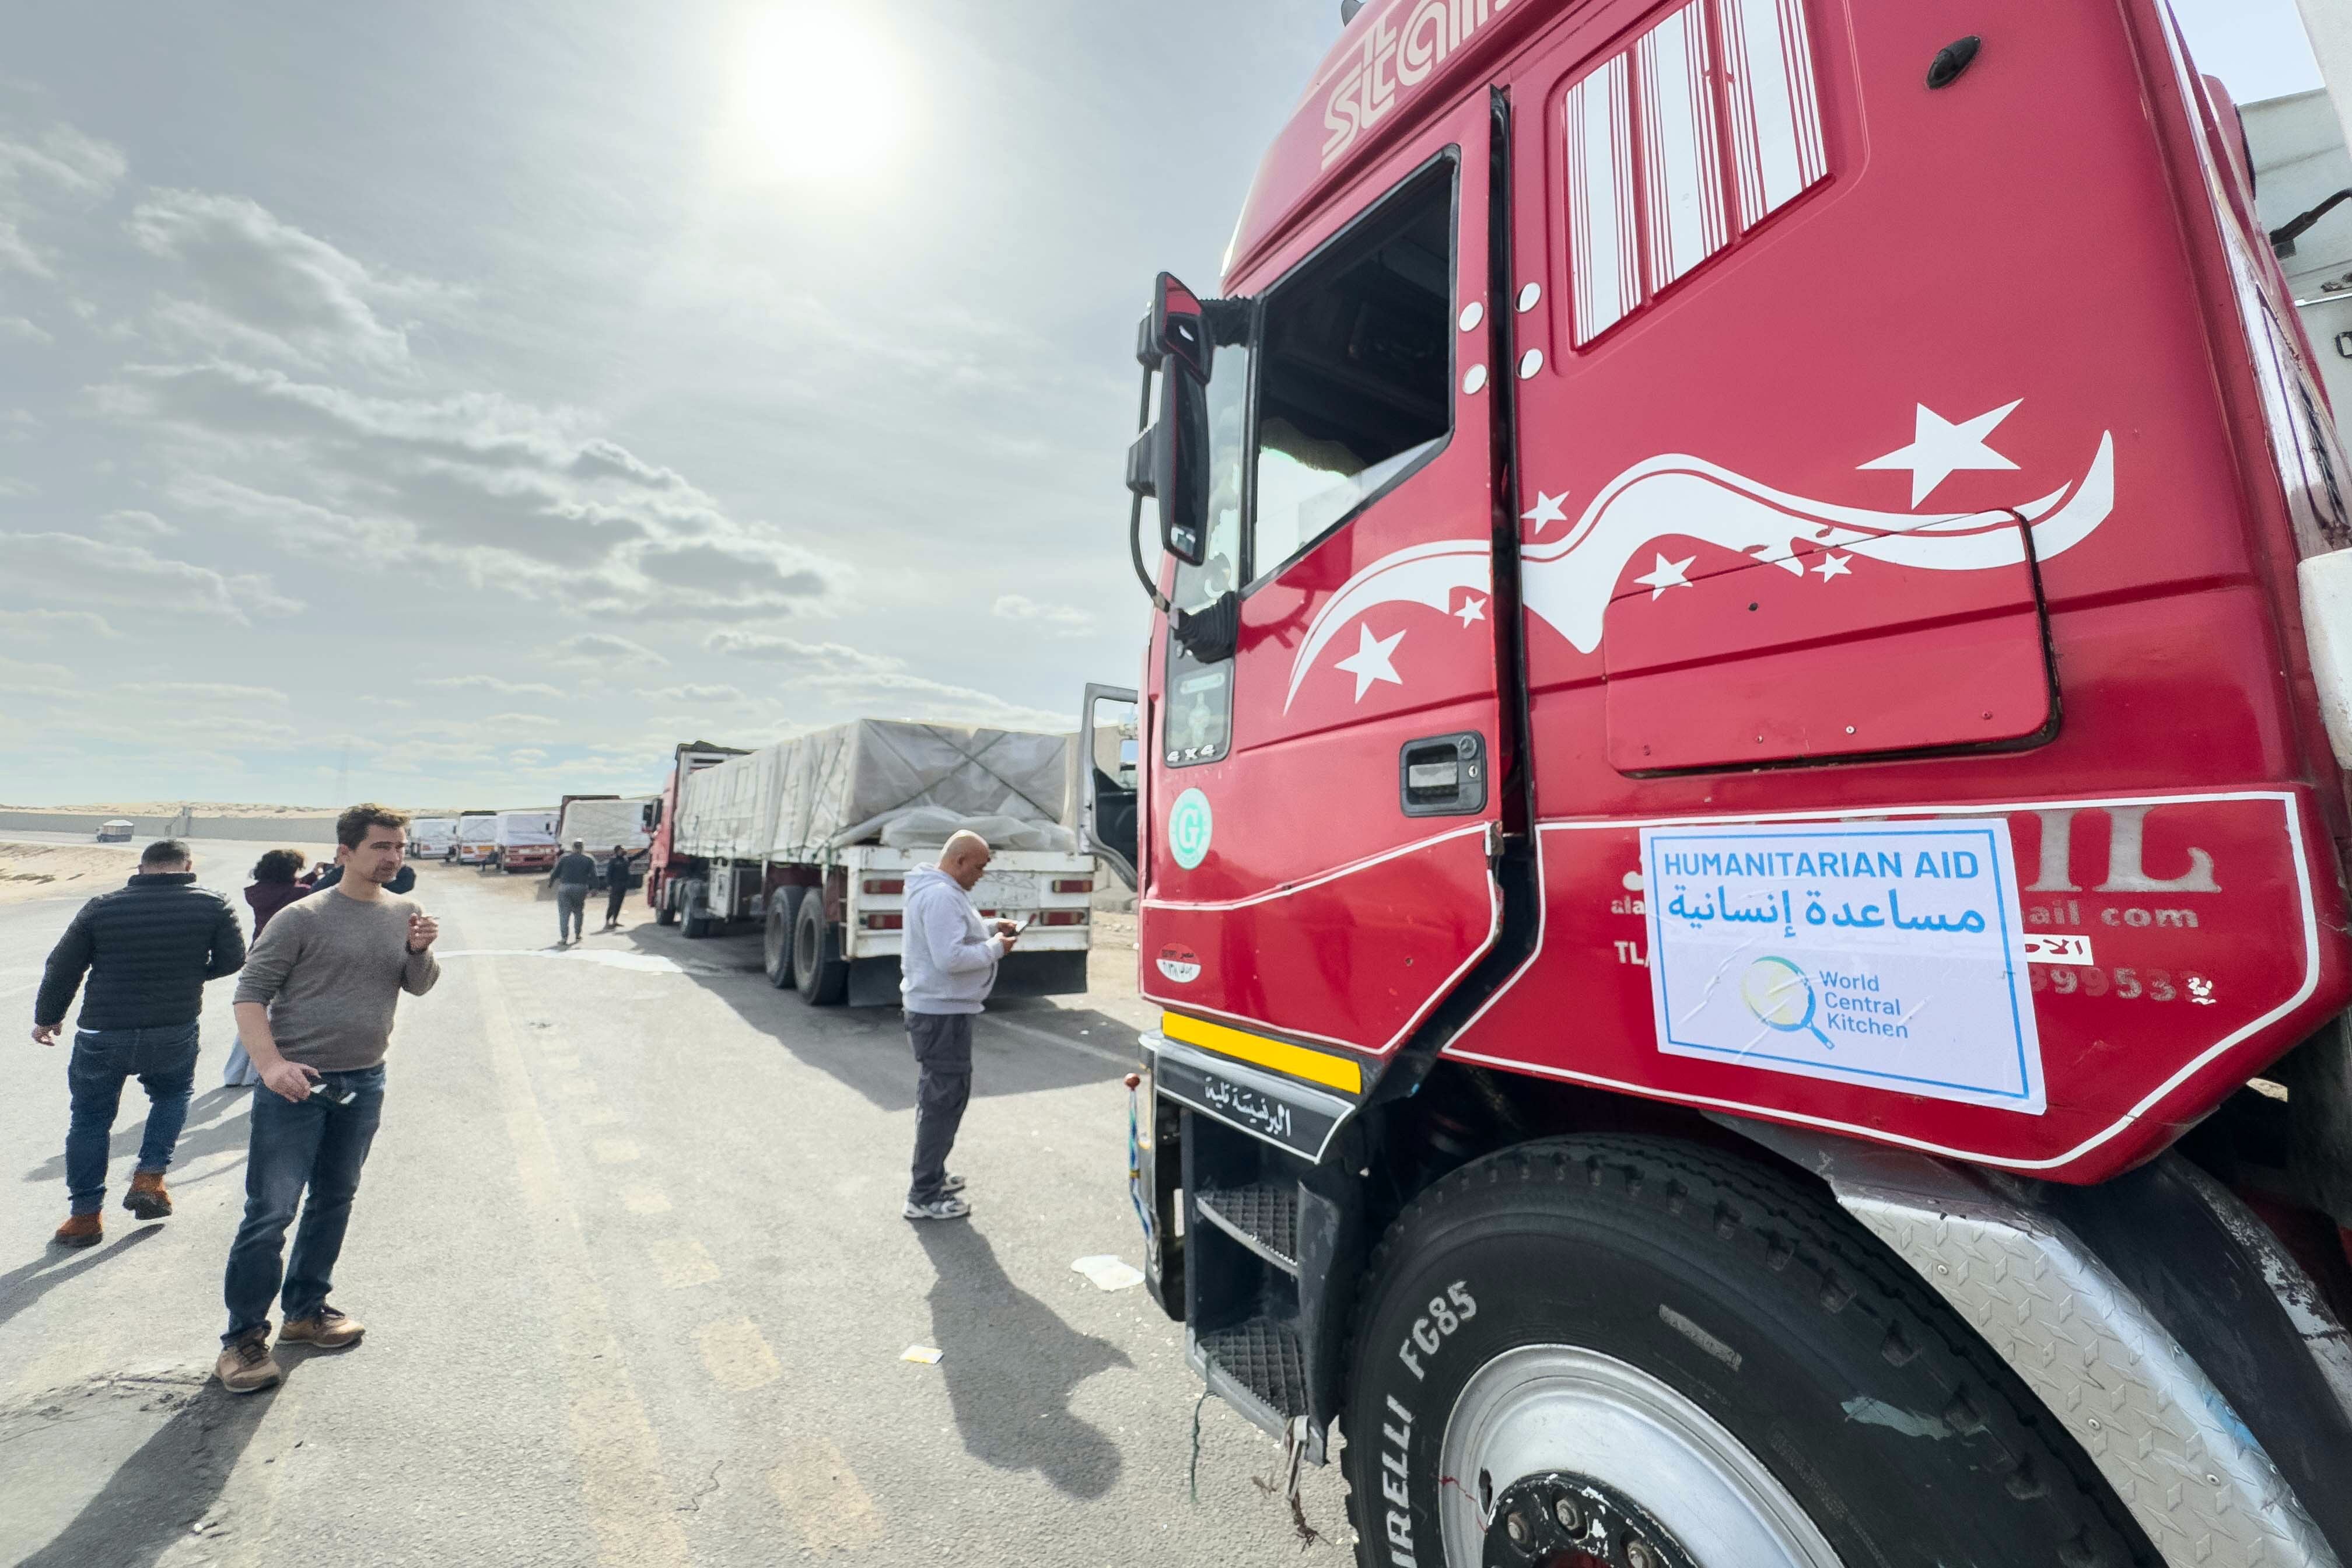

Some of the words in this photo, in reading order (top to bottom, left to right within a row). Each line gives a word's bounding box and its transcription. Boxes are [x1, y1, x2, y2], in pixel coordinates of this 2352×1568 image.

[1664, 852, 1903, 878] HUMANITARIAN
[1914, 851, 1979, 878] AID
[1668, 885, 1796, 937] إنسانية
[1805, 888, 1986, 933] مساعدة
[2022, 899, 2080, 926] ail
[2101, 907, 2199, 928] com
[1819, 970, 1880, 992] World
[1825, 992, 1901, 1016] Central
[1827, 1012, 1908, 1038] Kitchen
[1399, 1279, 1477, 1382] FG85
